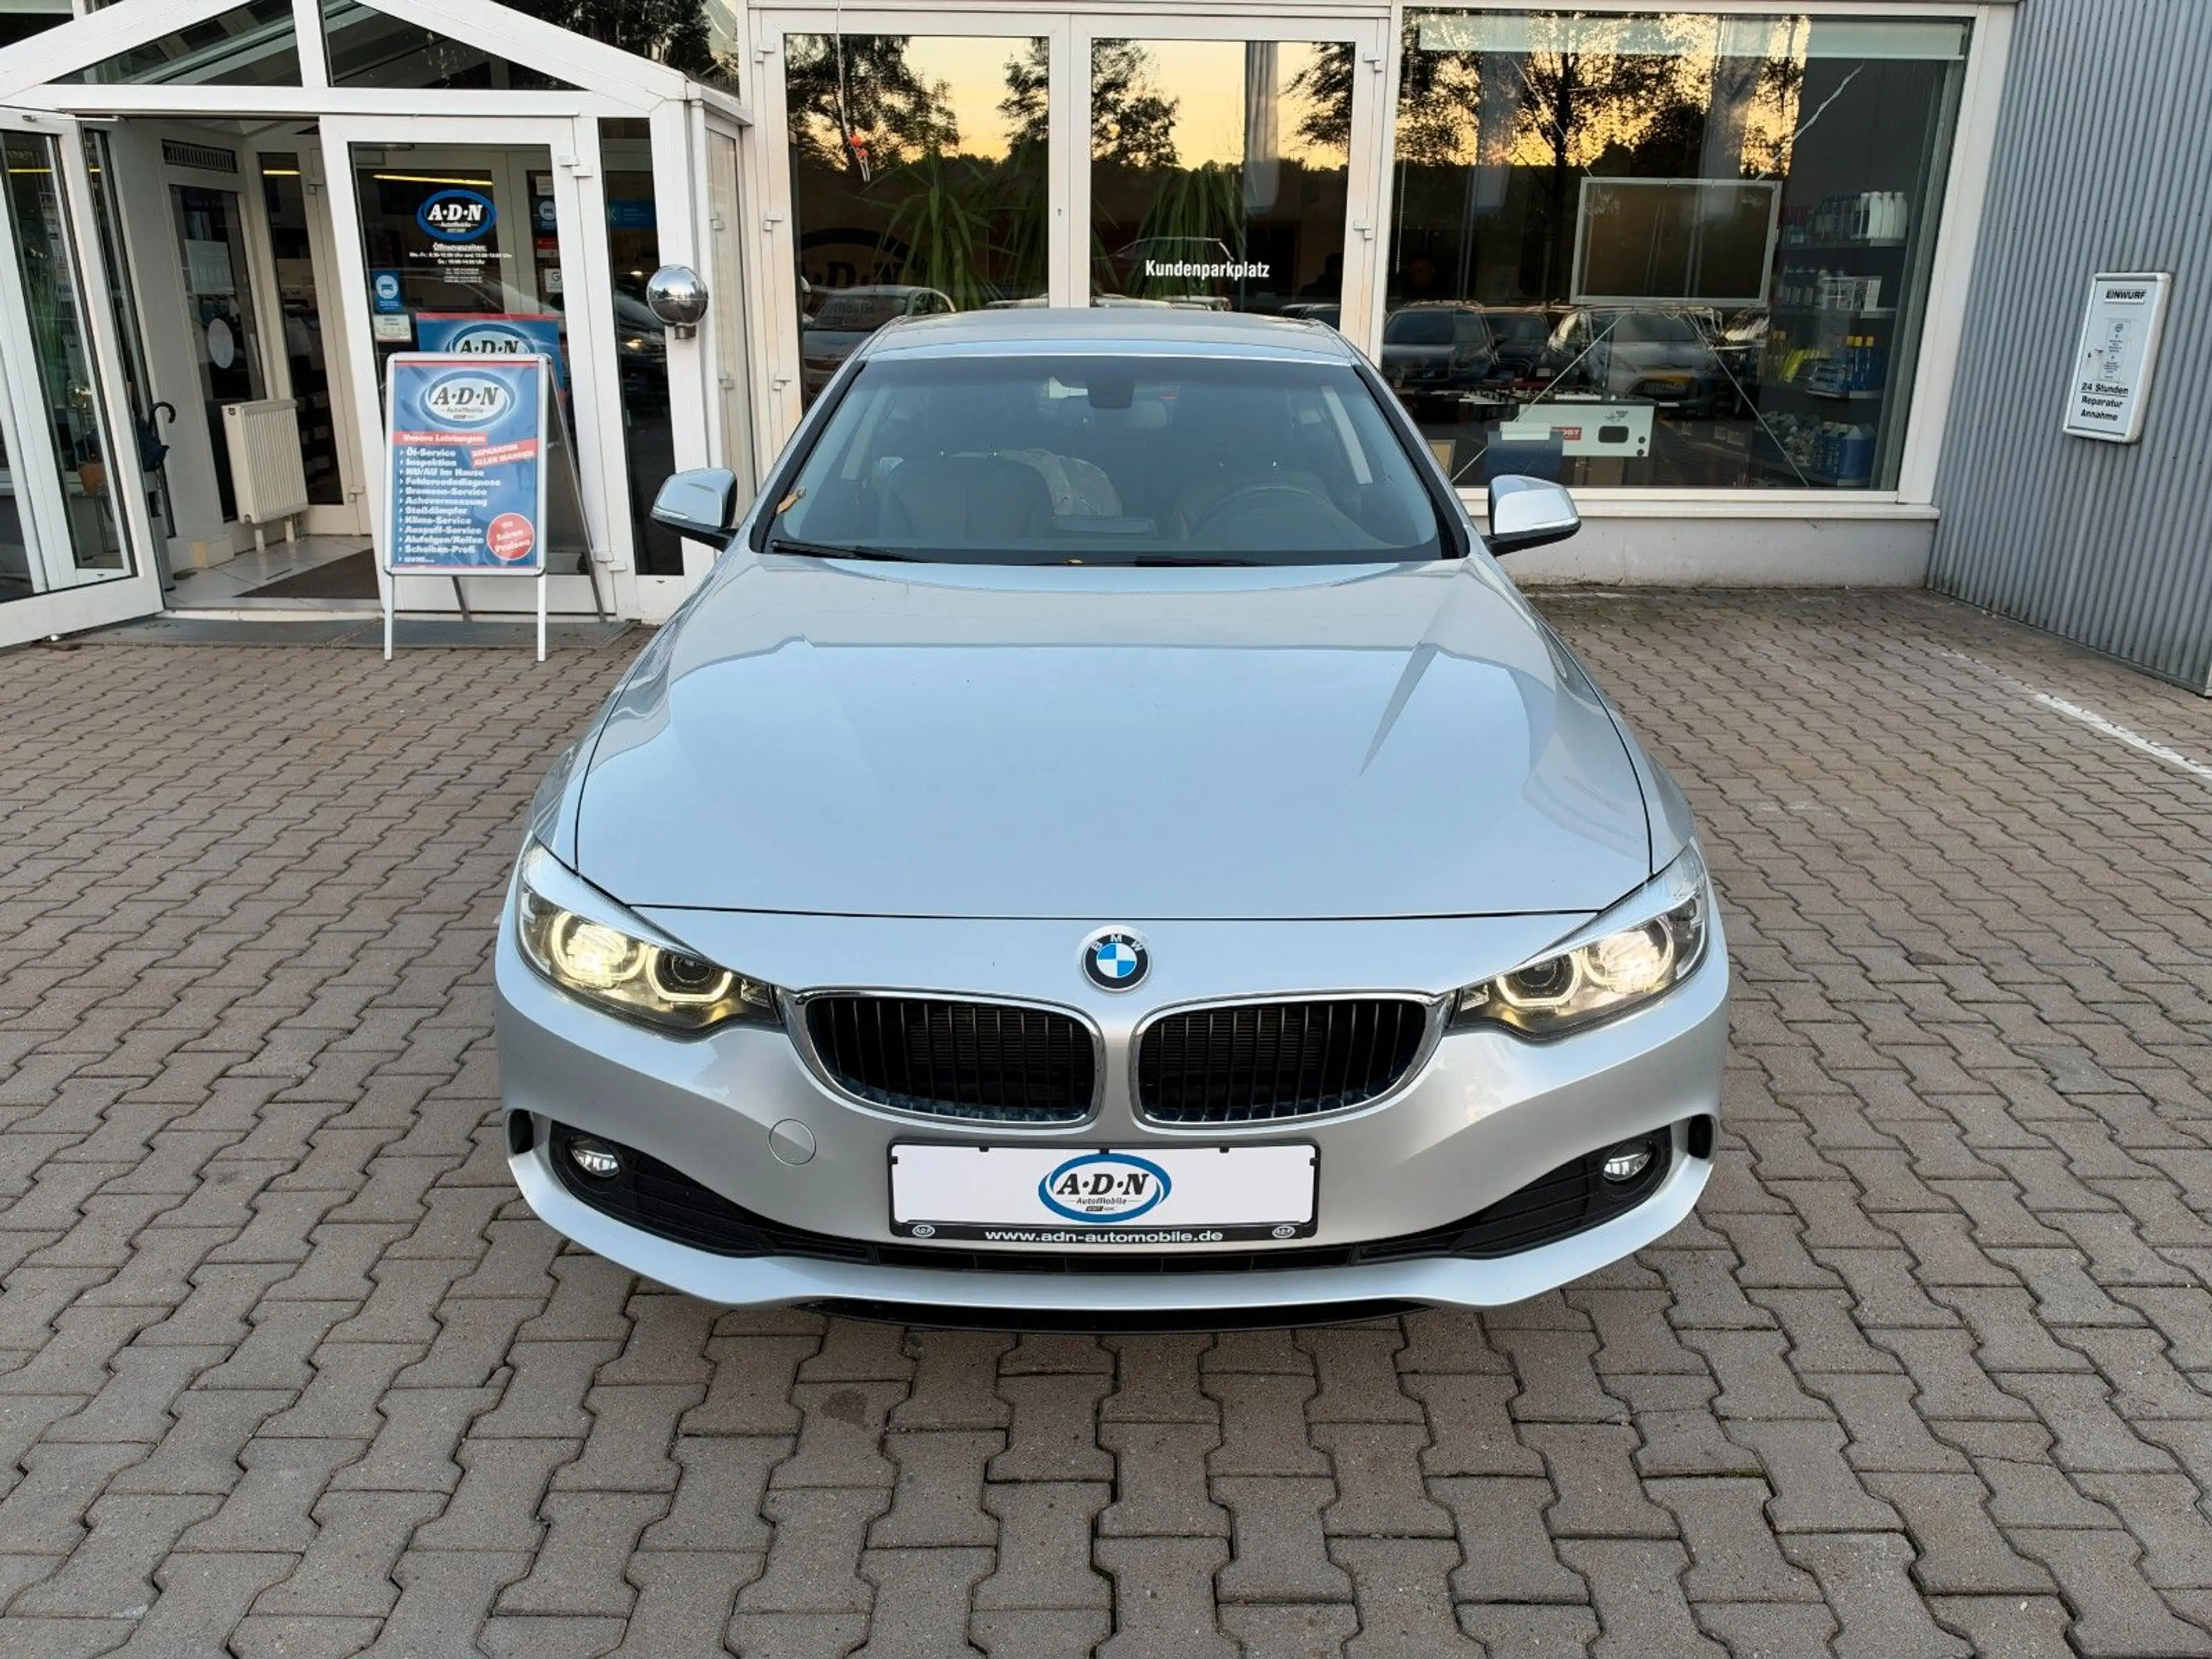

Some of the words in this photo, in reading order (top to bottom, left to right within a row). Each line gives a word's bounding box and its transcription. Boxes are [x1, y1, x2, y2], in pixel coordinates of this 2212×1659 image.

[1146, 260, 1270, 281] Kundenparkplatz
[2105, 290, 2146, 299] EINWURF
[2081, 382, 2092, 391] 24
[2094, 383, 2128, 395] Stunden
[2081, 395, 2123, 408] Reparatur
[2081, 408, 2118, 421] Annahme
[406, 446, 456, 457] Öl-Service
[406, 459, 457, 468] Inspektion
[454, 468, 485, 477] Hause
[405, 516, 472, 525] Klima-Service
[404, 525, 483, 536] Auspuff-Service
[404, 545, 476, 554] Scheiben-Profi
[1090, 934, 1143, 952] BMW
[1076, 1197, 1128, 1205] AutoMobile
[985, 1230, 1224, 1243] www.adn-automobile.de
